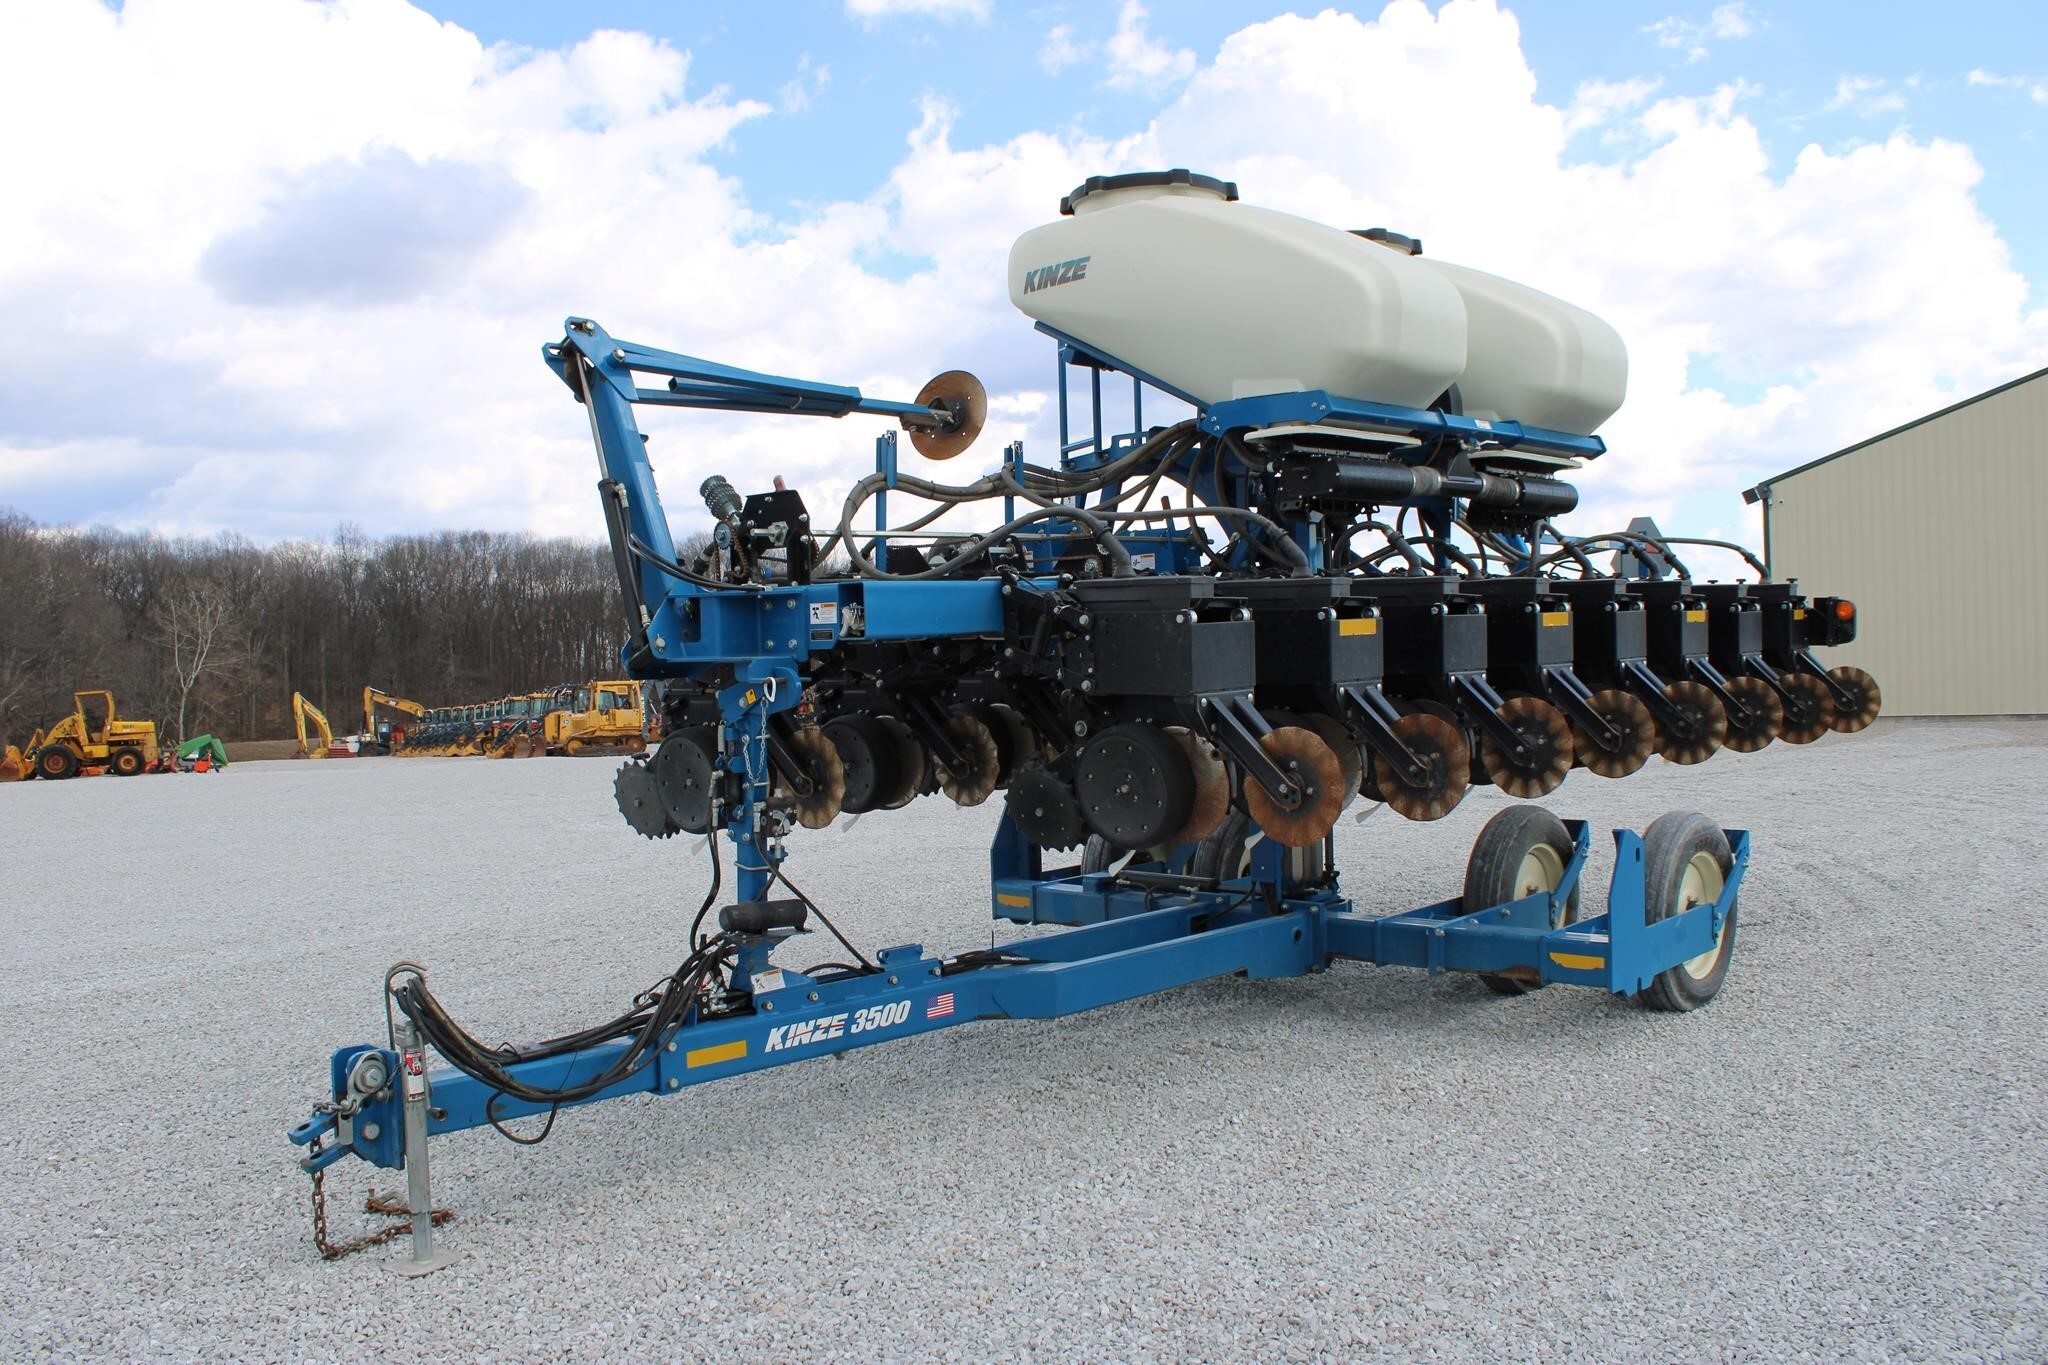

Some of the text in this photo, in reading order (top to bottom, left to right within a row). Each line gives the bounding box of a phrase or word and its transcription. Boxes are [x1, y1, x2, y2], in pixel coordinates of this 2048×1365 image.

[1023, 255, 1091, 295] KINZE
[764, 999, 912, 1053] KINZE 3500
